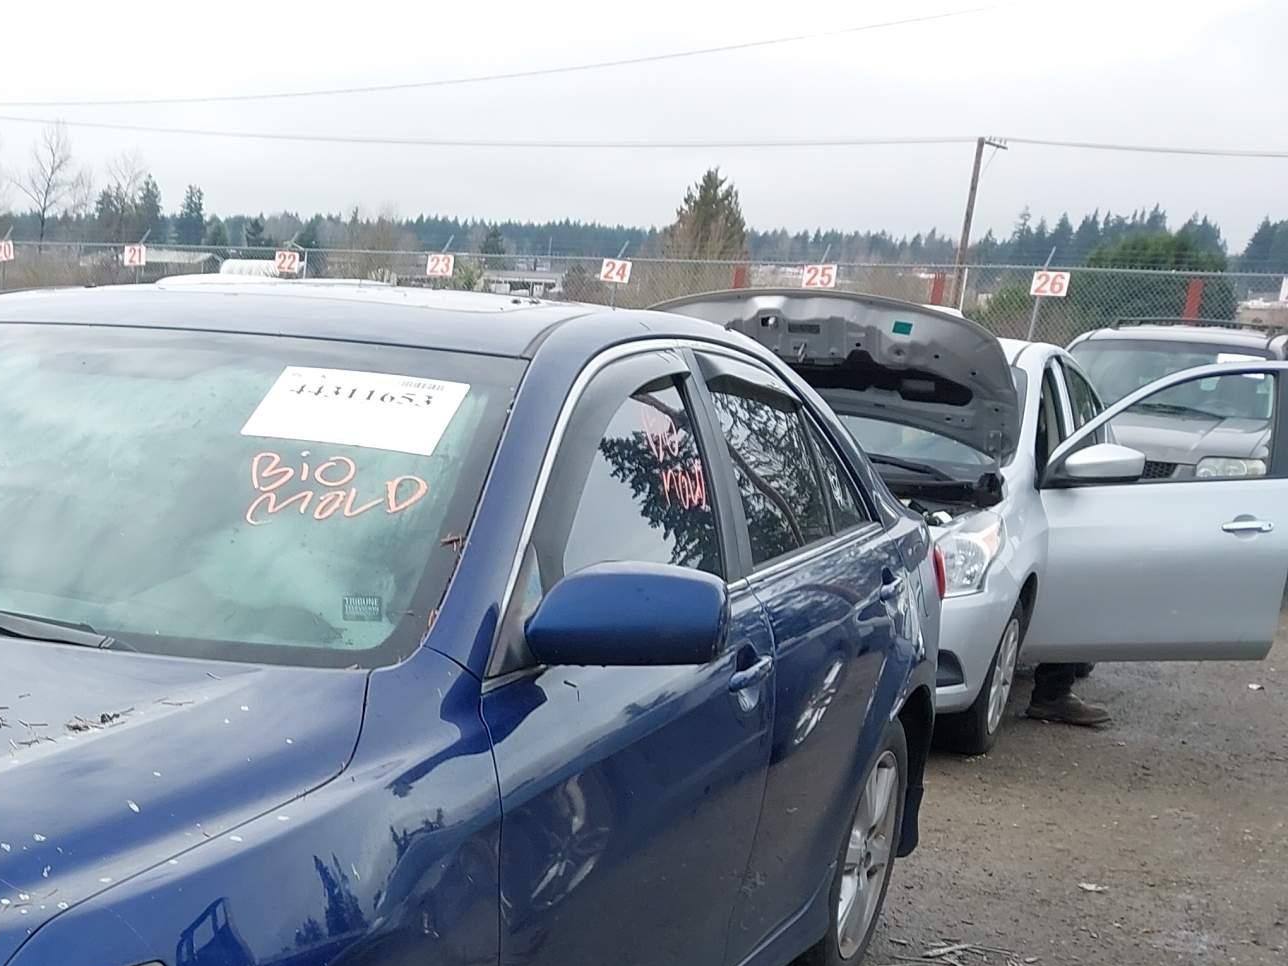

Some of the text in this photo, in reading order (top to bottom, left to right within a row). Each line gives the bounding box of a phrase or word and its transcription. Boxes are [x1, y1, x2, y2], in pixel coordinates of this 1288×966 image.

[128, 247, 142, 264] 21
[278, 252, 296, 271] 22
[428, 255, 450, 274] 23
[603, 261, 626, 280] 24
[805, 266, 831, 285] 25
[1034, 273, 1064, 294] 26
